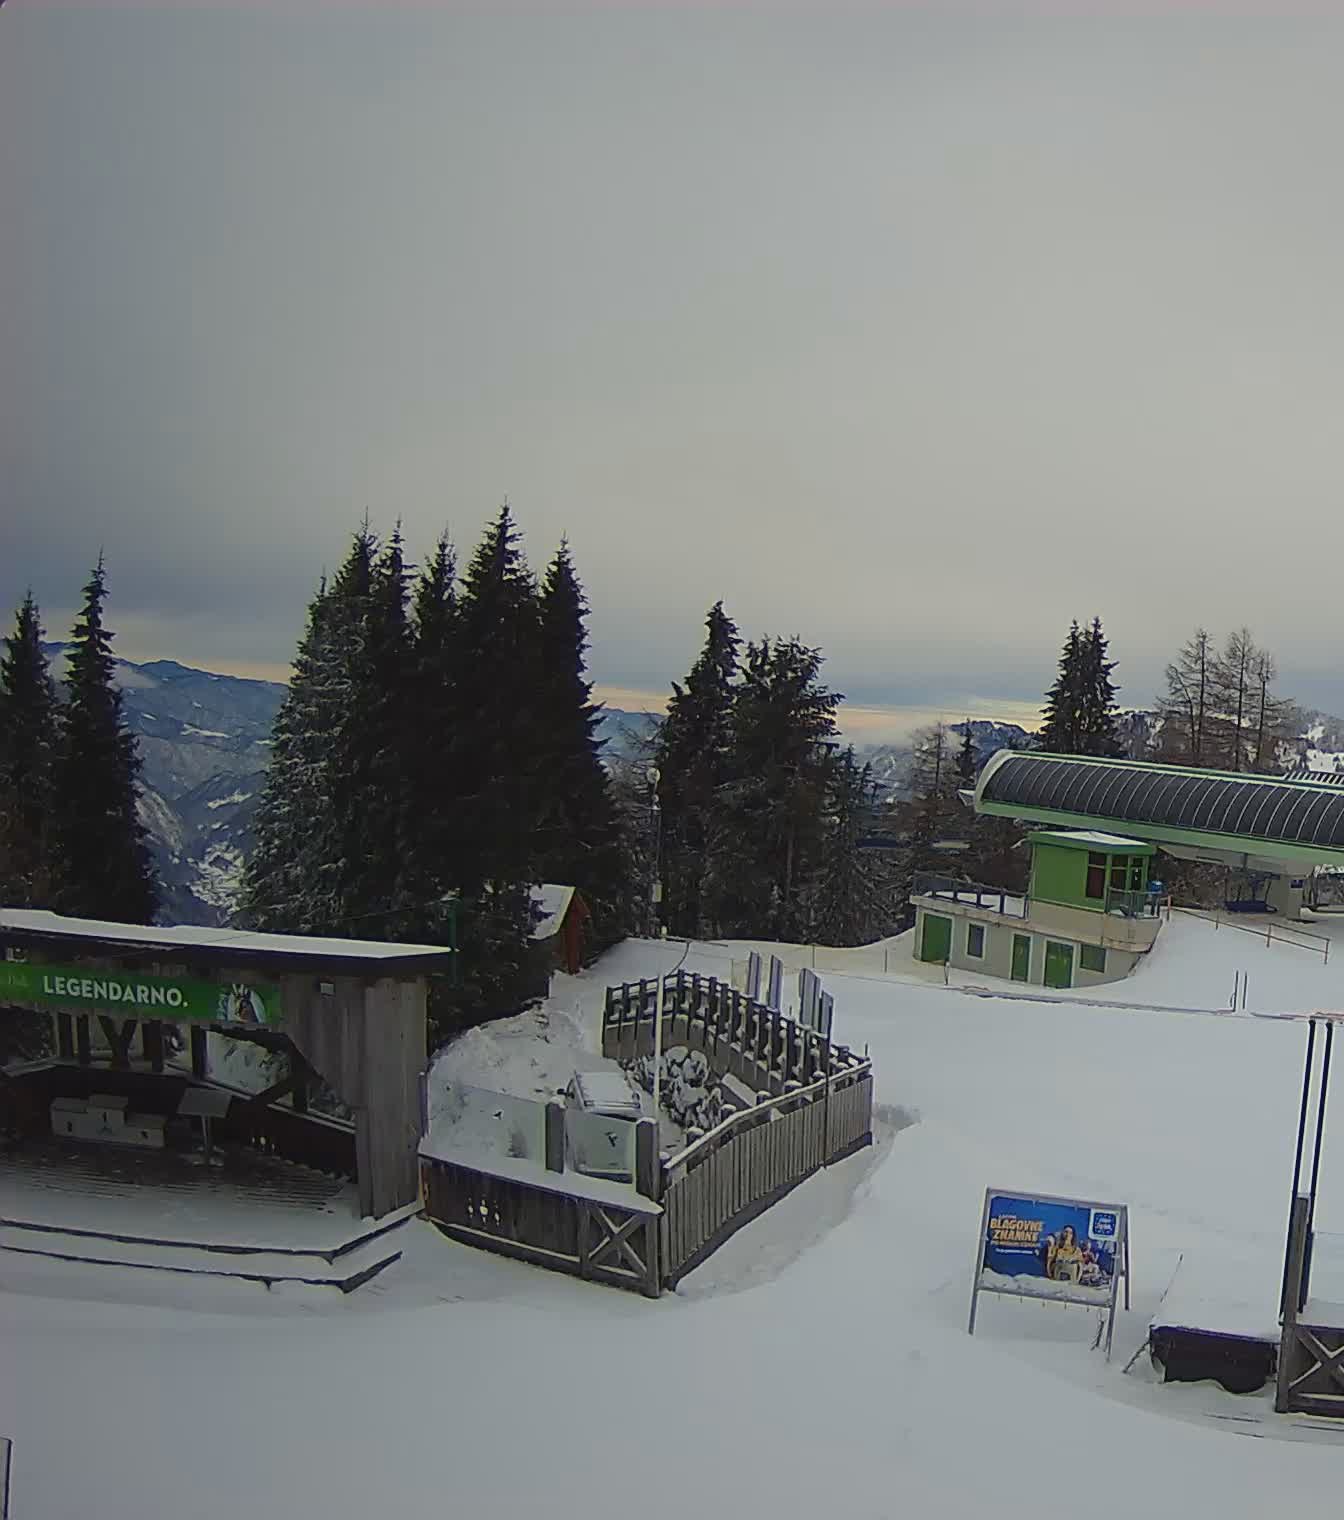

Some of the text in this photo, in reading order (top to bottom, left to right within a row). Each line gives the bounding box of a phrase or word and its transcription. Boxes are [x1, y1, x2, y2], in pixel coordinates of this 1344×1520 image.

[43, 975, 189, 1008] LEGENDARNO.
[990, 1217, 1042, 1232] BLAGOVNE
[993, 1230, 1039, 1242] ZNAMKE
